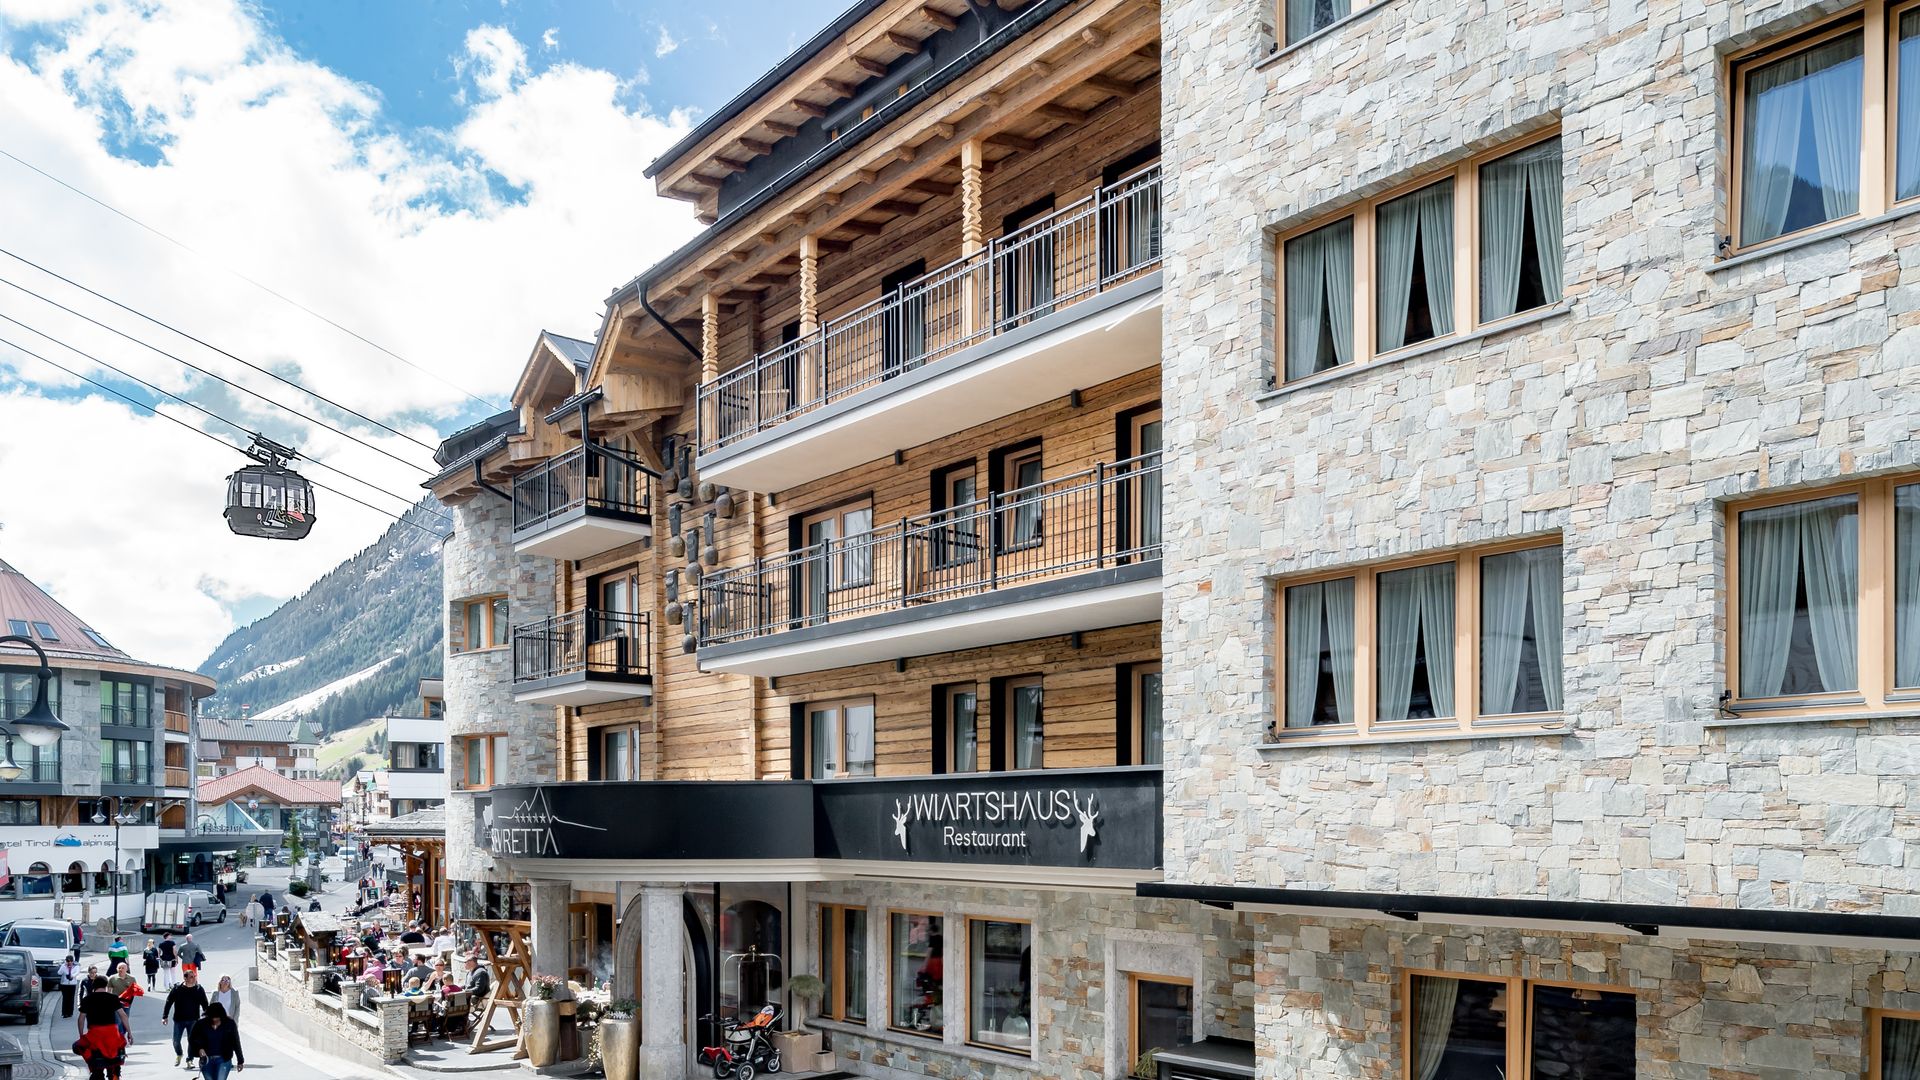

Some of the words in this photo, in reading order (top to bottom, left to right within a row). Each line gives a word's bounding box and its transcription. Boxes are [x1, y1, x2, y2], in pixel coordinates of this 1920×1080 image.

[914, 790, 1070, 820] WIARTSHAUS
[25, 839, 51, 847] Tirol
[83, 839, 102, 847] alpin
[944, 826, 1026, 847] Restaurant
